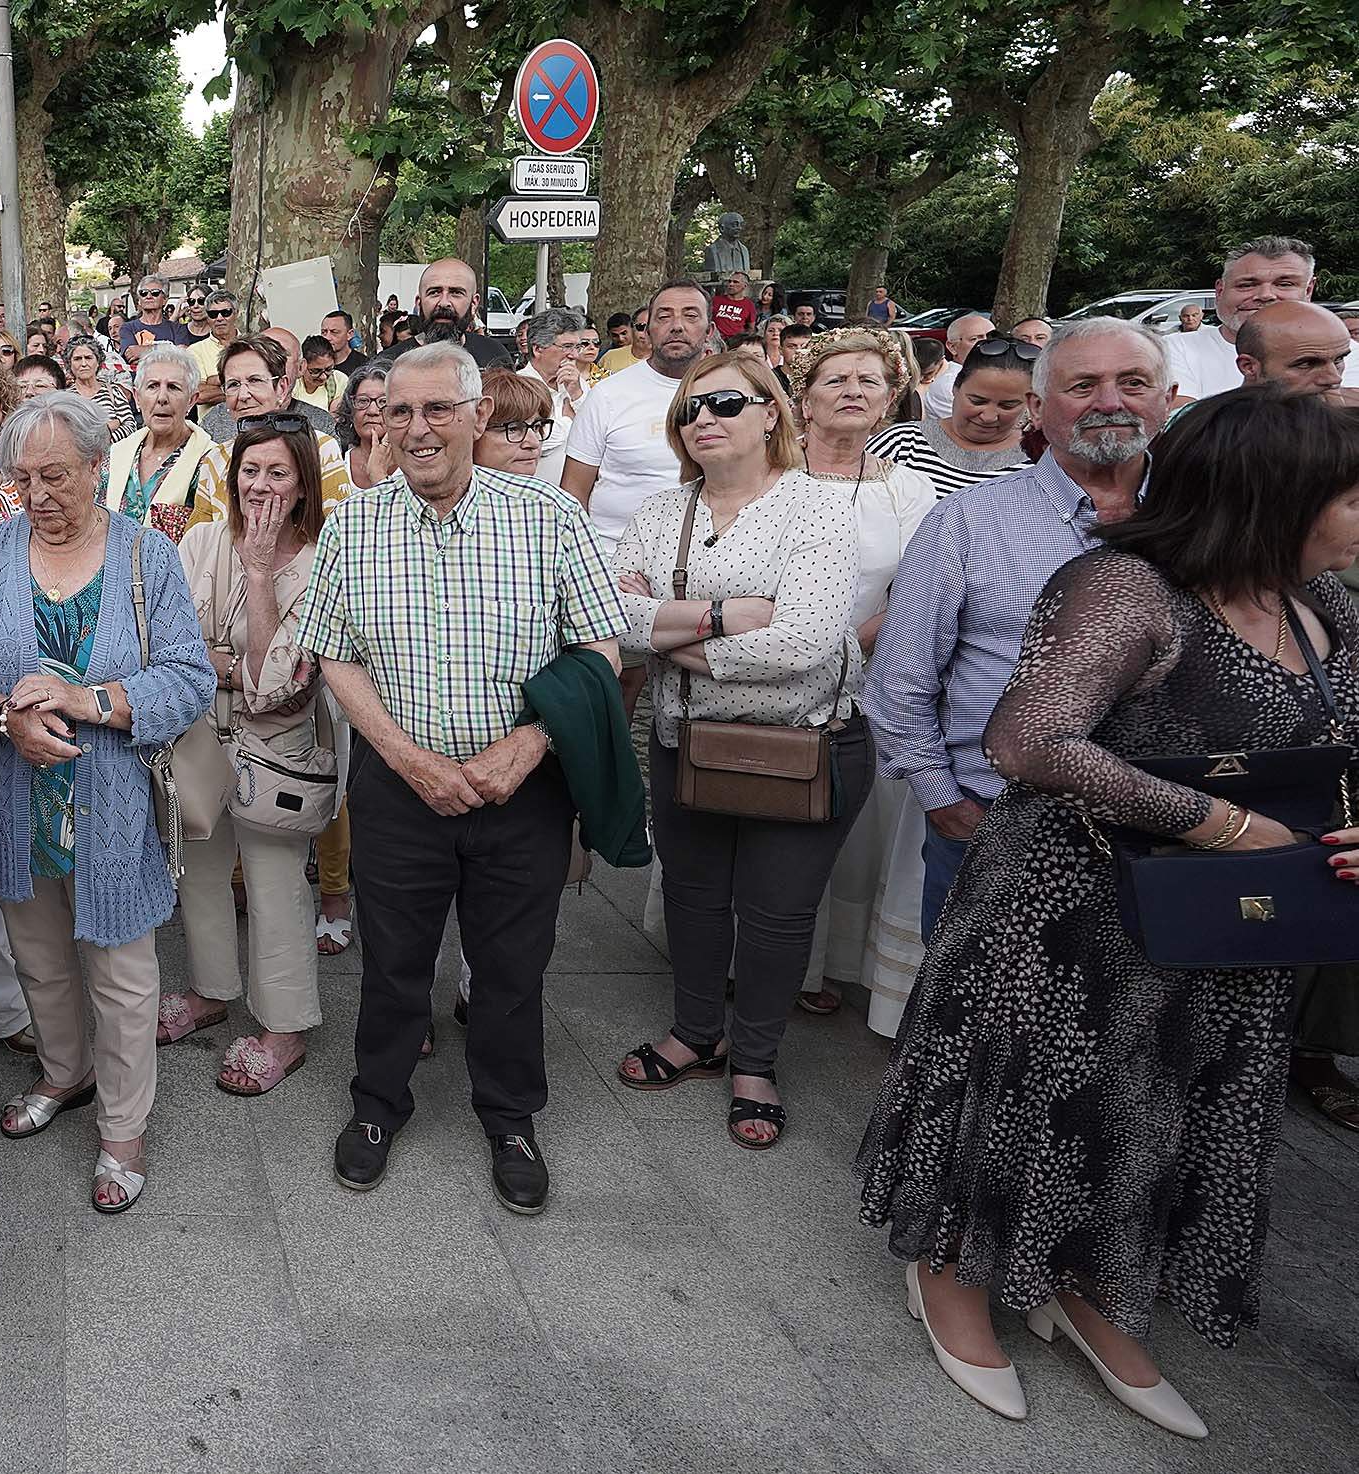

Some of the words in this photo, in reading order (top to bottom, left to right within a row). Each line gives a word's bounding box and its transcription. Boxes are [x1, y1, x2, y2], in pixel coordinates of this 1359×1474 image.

[546, 164, 575, 175] SERVIZOS
[542, 178, 550, 187] 30
[550, 178, 578, 188] MINUTOS
[509, 210, 597, 228] HOSPEDERIA
[718, 304, 743, 315] NEW
